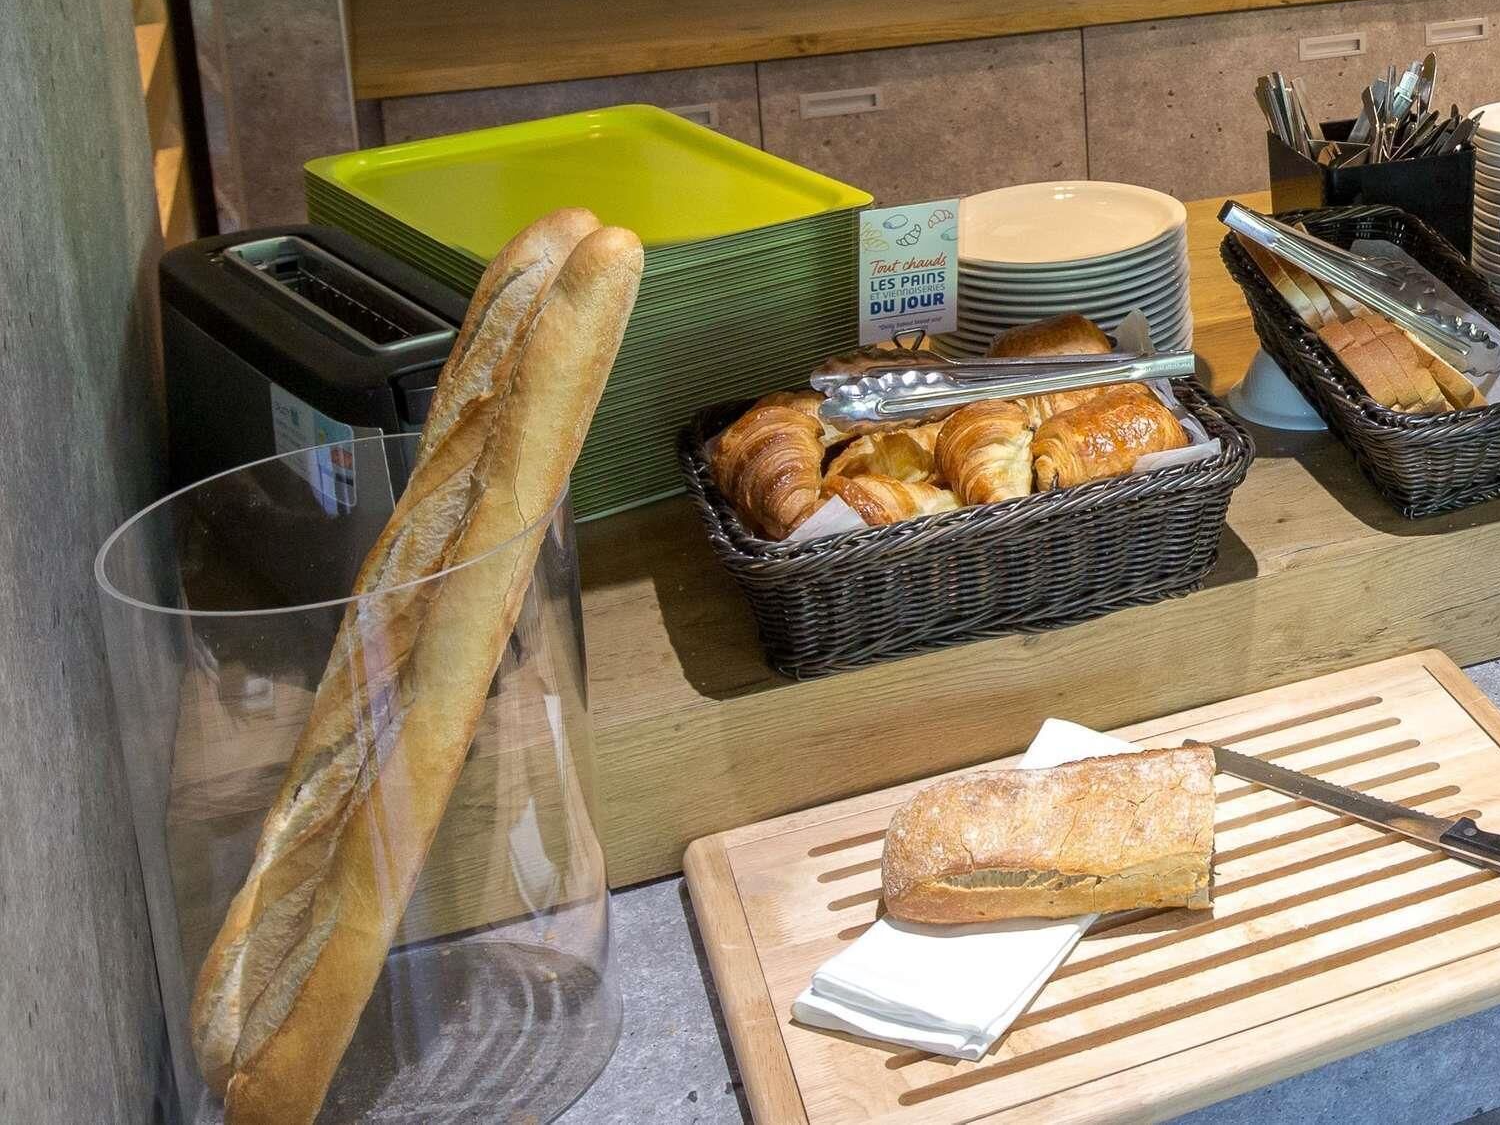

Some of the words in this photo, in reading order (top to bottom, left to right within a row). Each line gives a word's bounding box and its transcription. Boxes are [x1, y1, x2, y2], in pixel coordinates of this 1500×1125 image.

[870, 259, 899, 275] Tout
[902, 251, 947, 271] chauds
[870, 277, 895, 292] LES
[901, 271, 945, 288] PAINS
[870, 291, 881, 300] ET
[870, 300, 895, 315] DU
[901, 292, 944, 314] JOUR
